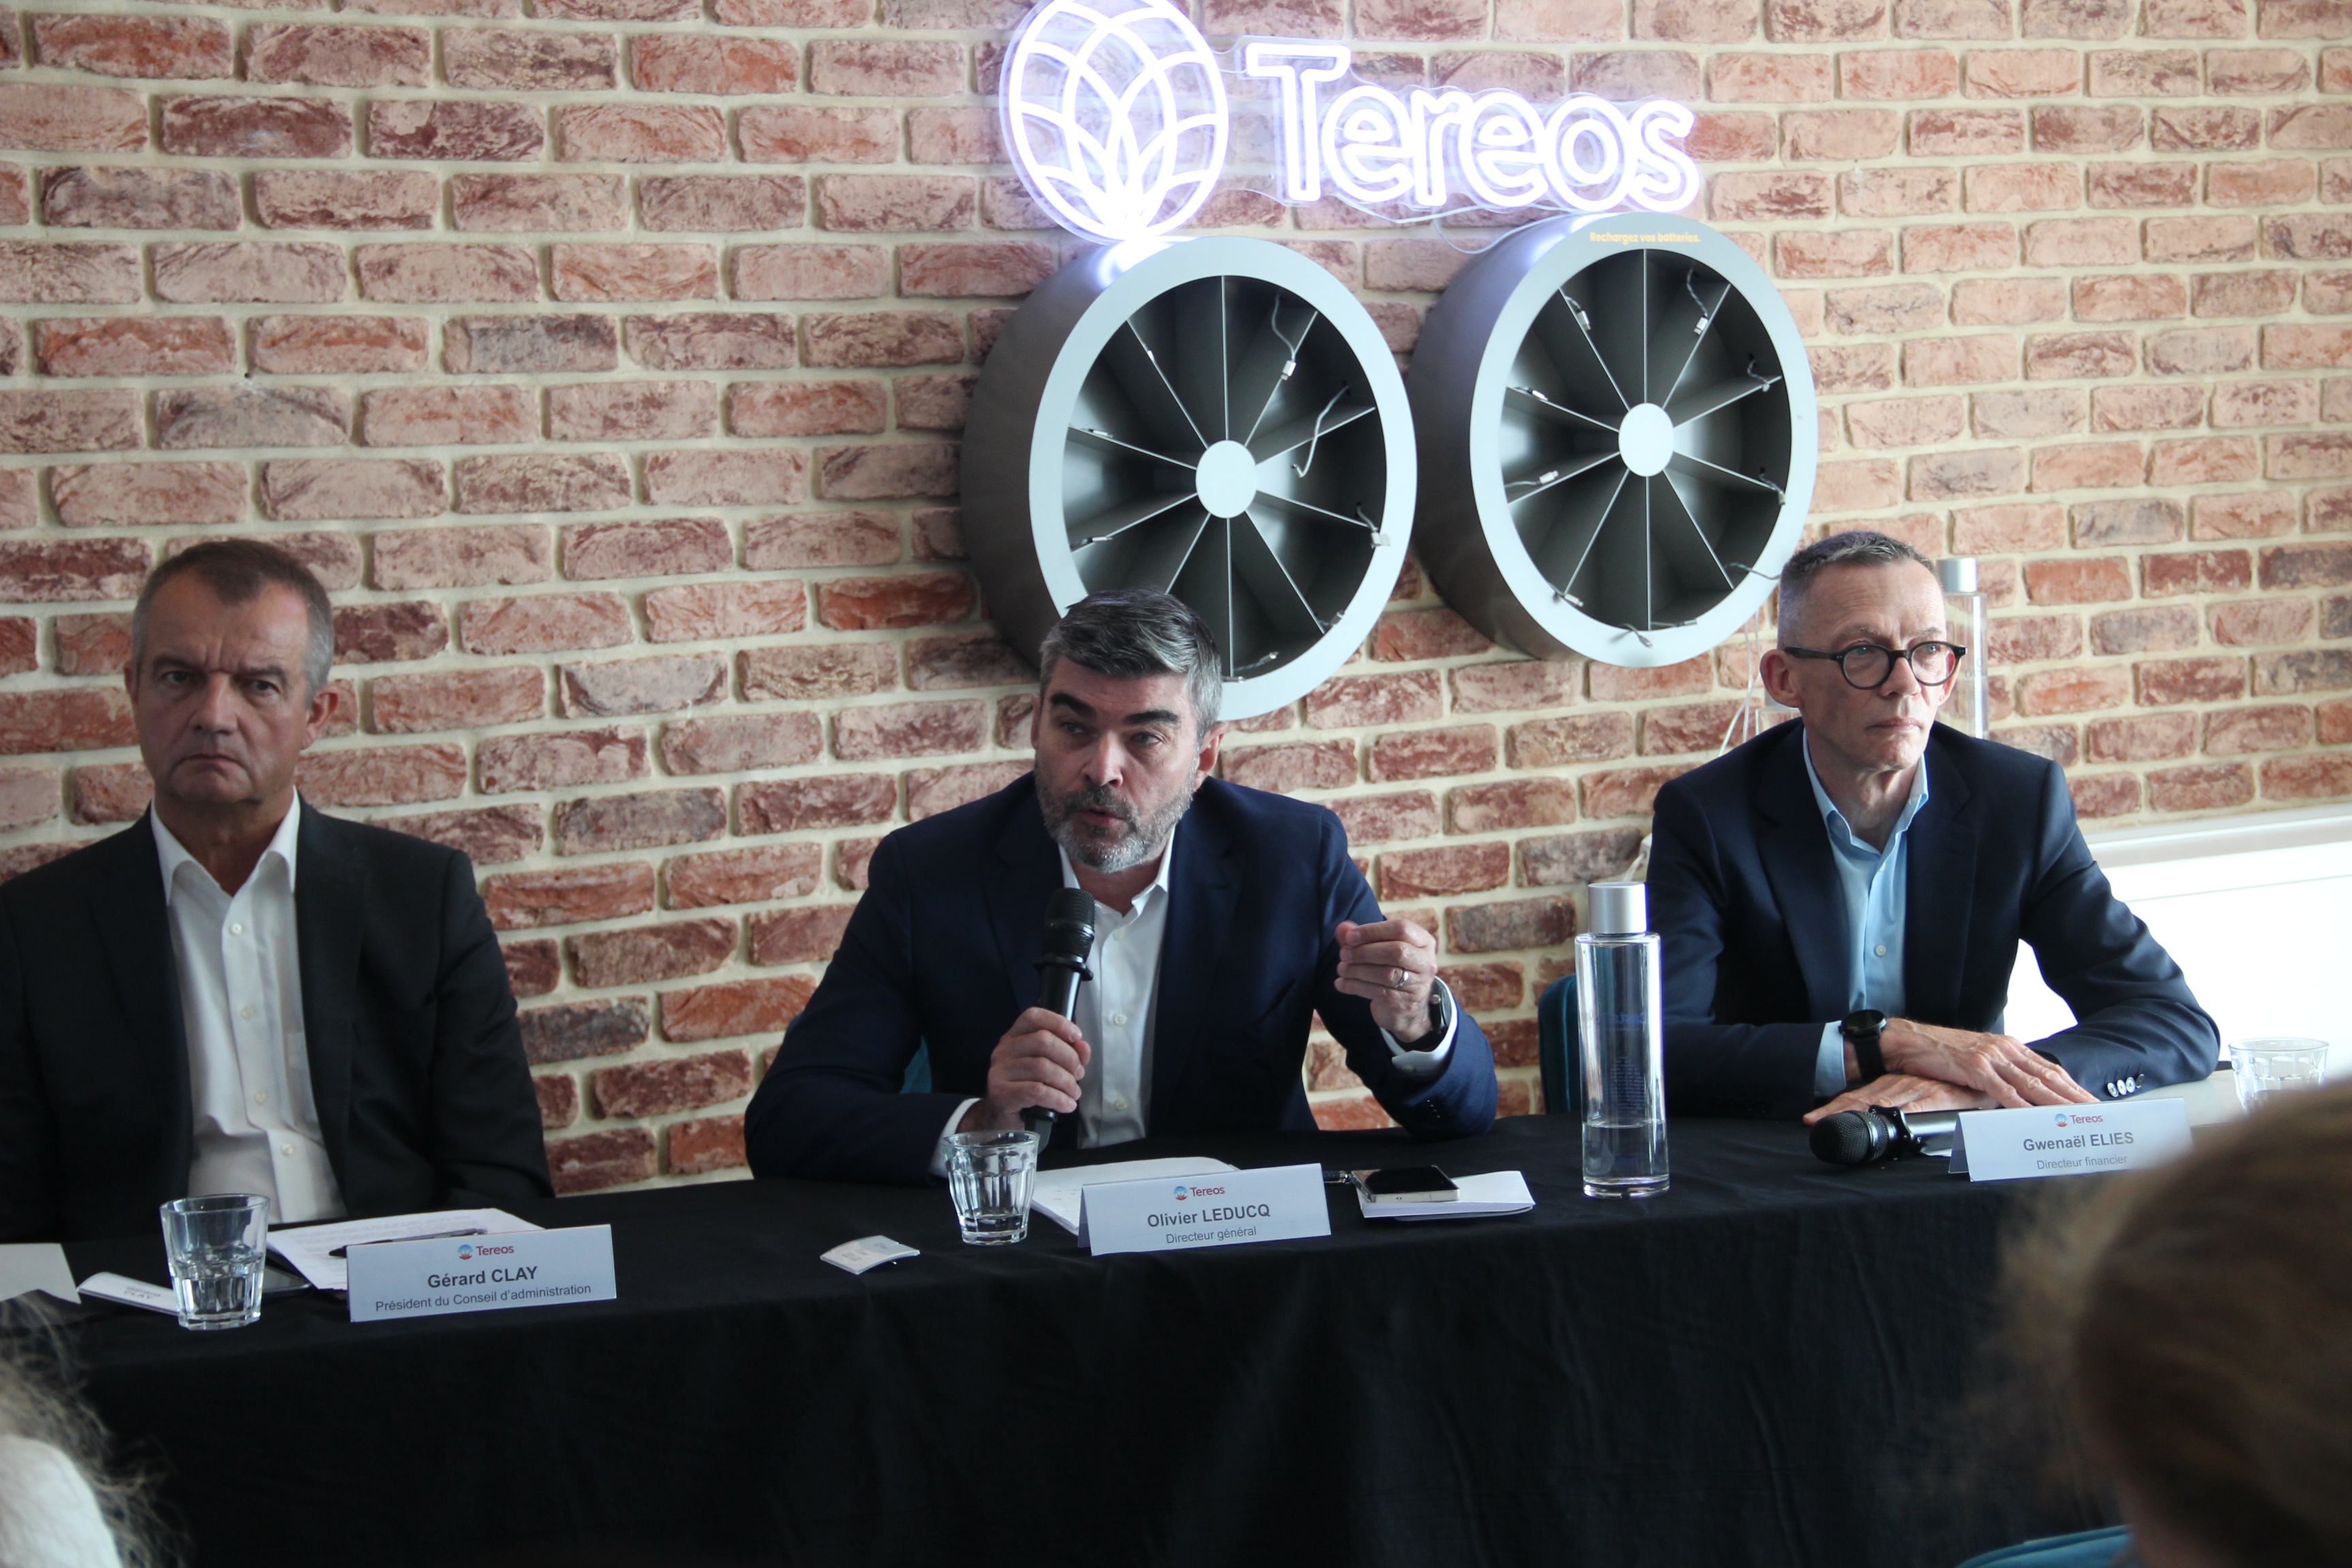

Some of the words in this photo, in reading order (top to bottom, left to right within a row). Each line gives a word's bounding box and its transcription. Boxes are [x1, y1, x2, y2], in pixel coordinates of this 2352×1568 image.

[1246, 42, 1700, 212] Tereos
[1590, 232, 1637, 245] Rechargez
[1639, 233, 1656, 242] vos
[1658, 232, 1701, 242] batteries.
[2070, 1115, 2104, 1124] Tereos
[2023, 1135, 2086, 1152] Gwenaël
[2090, 1132, 2134, 1147] ELIES
[2037, 1158, 2082, 1170] Directeur
[2085, 1156, 2127, 1167] financier
[1190, 1186, 1225, 1197] Tereos
[1147, 1212, 1198, 1227] Olivier
[1202, 1203, 1271, 1222] LEDUCQ
[1166, 1230, 1214, 1244] Directeur
[1218, 1226, 1257, 1241] général
[476, 1245, 514, 1256] Tereos
[427, 1271, 486, 1288] Gérard
[491, 1266, 538, 1282] CLAY
[376, 1298, 432, 1312] Président
[436, 1295, 450, 1307] du
[453, 1292, 497, 1305] Conseil
